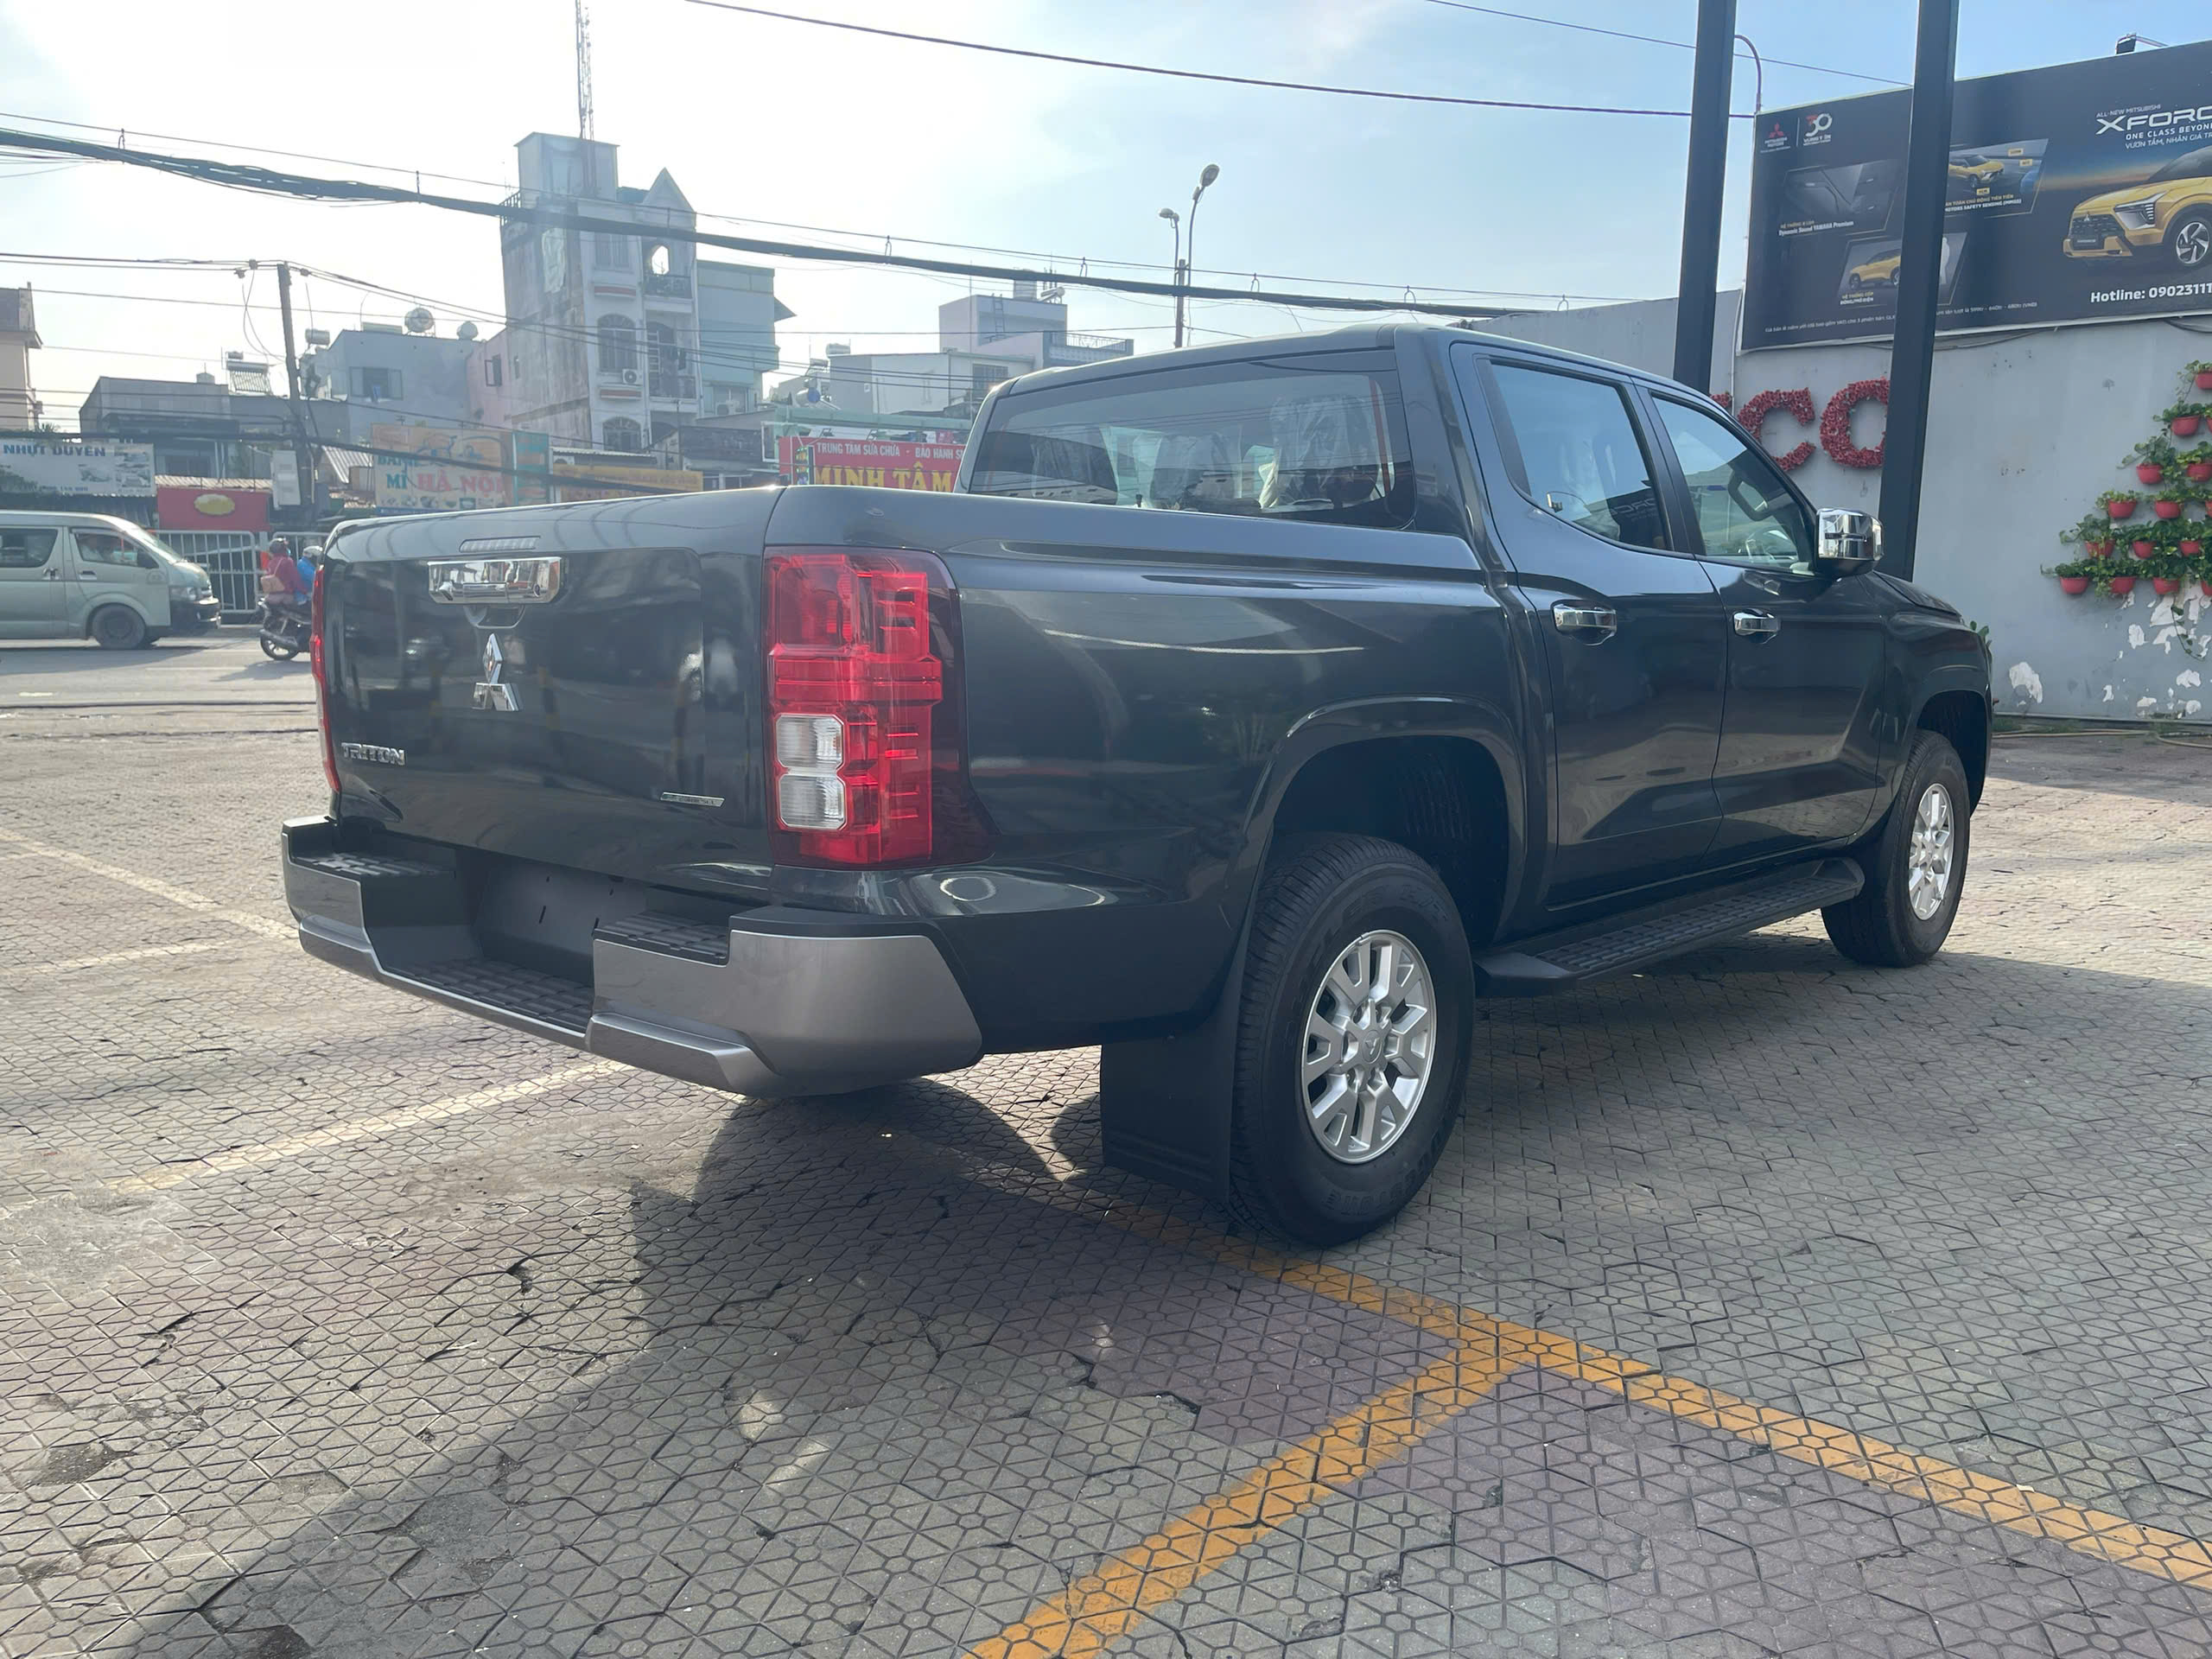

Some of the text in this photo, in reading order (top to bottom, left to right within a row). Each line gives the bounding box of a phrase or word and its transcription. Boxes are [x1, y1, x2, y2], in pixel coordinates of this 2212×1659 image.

[2126, 104, 2161, 113] MITSUBISHI
[2147, 128, 2176, 138] CLASS
[2178, 123, 2212, 133] BEYON
[2090, 289, 2145, 302] Hotline:
[817, 441, 900, 456] TRUNG TÂM SỬA CHỮA
[915, 442, 931, 459] BẢO
[933, 445, 954, 460] HÀNH
[892, 460, 952, 493] TÂM
[340, 741, 405, 766] TRITON
